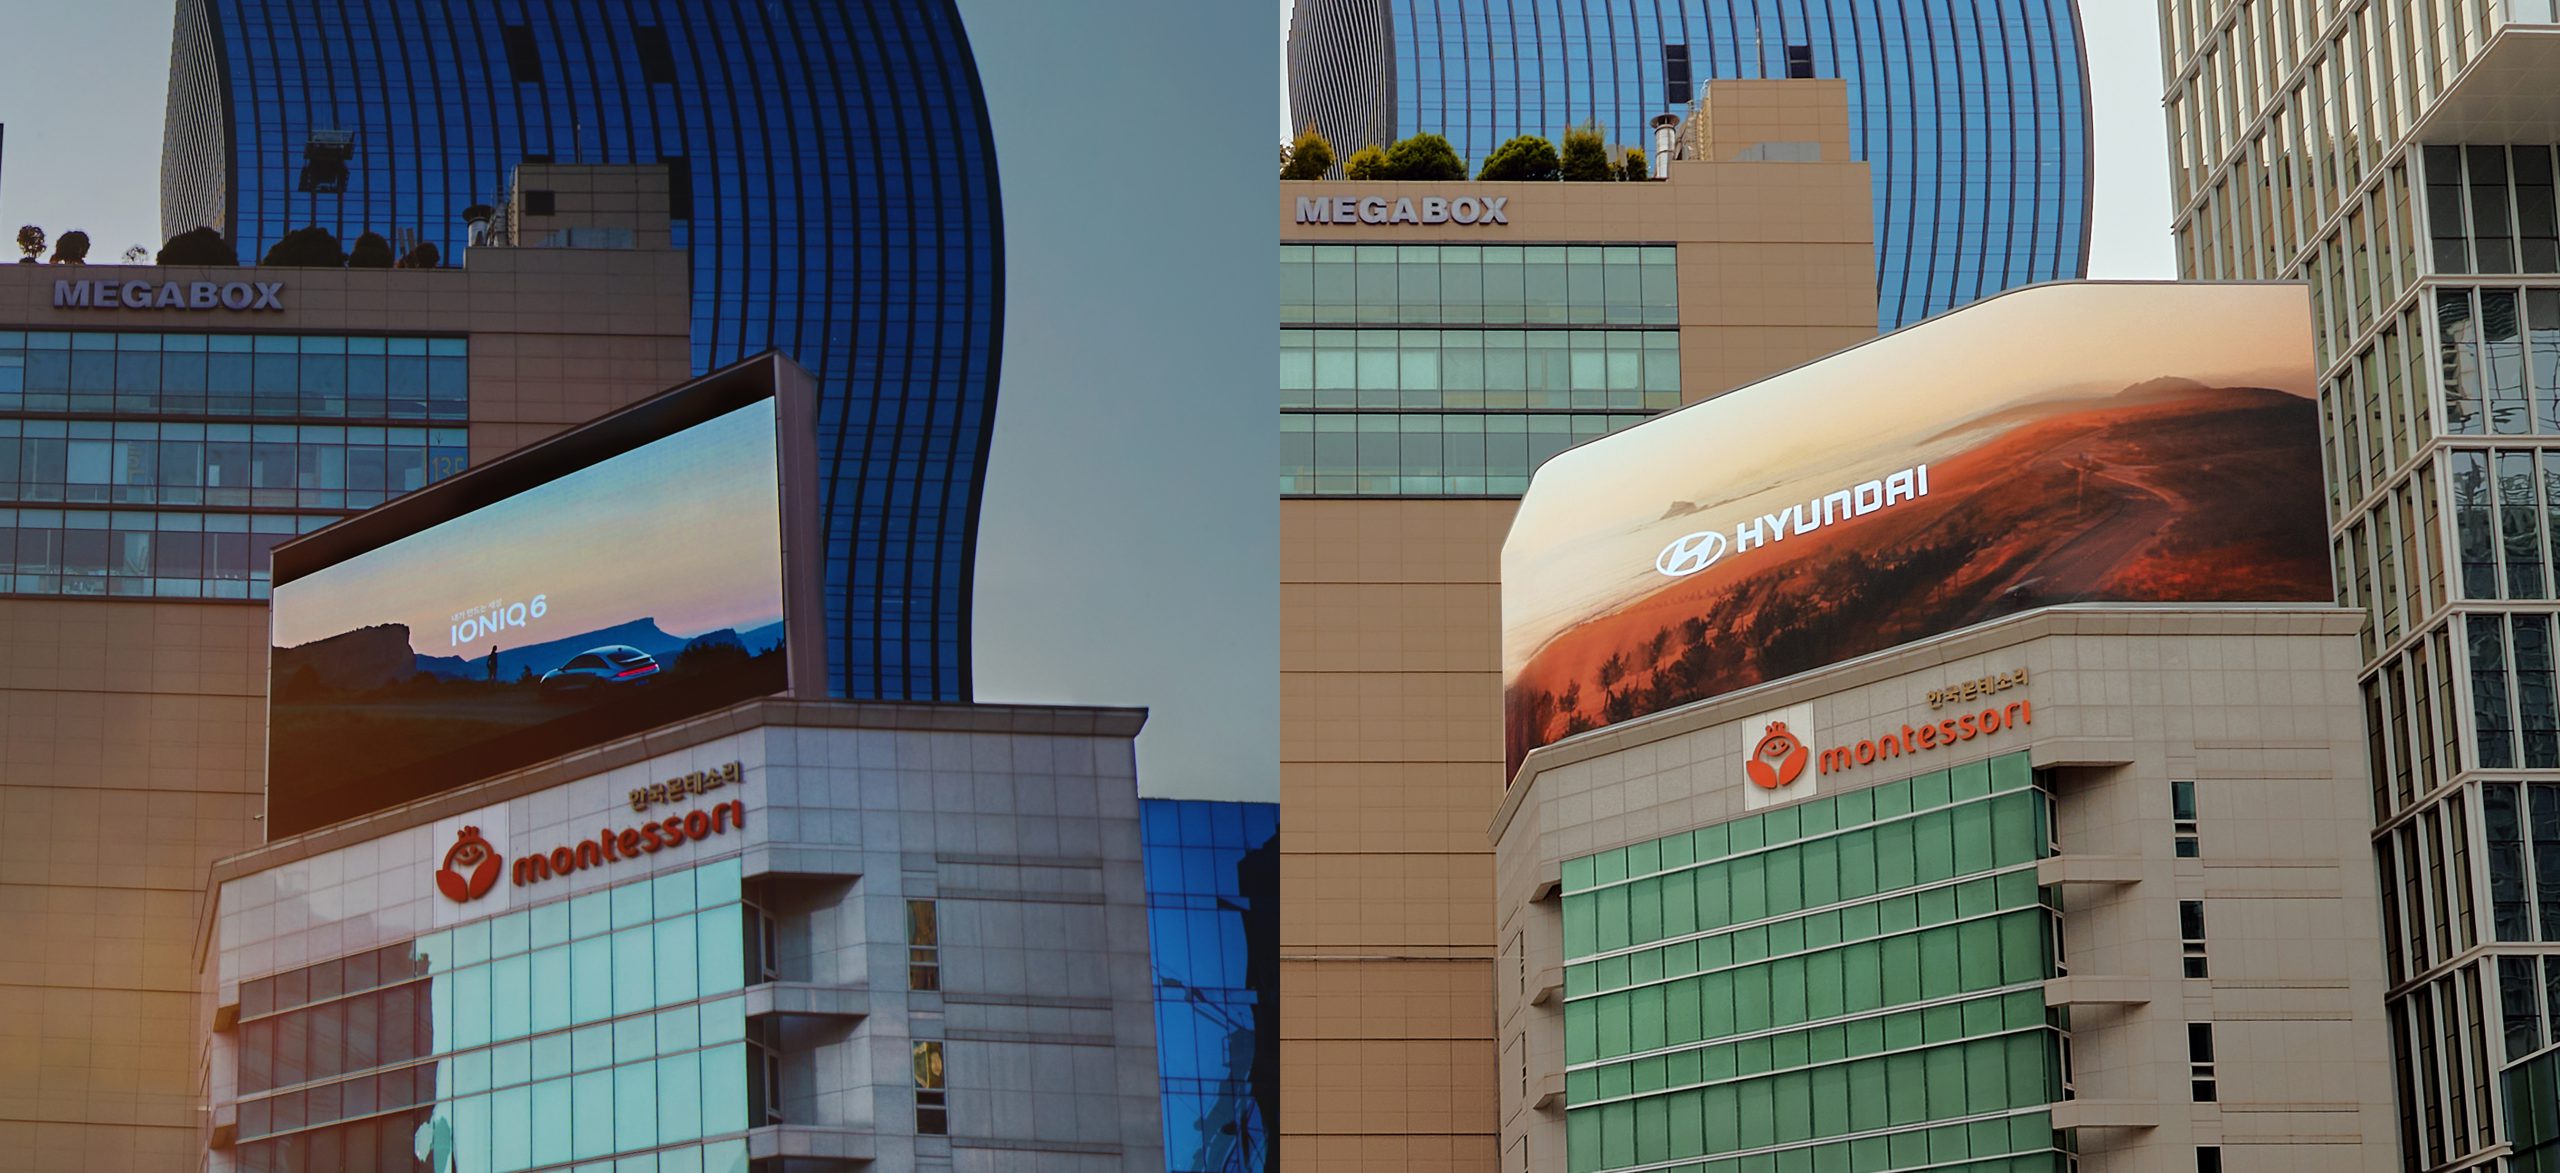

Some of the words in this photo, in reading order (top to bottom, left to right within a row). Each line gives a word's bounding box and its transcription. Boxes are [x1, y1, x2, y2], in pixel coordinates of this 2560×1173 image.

[1295, 196, 1509, 225] MEGABOX
[53, 279, 285, 311] MEGABOX
[1736, 463, 1929, 553] HYUNDAI
[451, 602, 526, 647] IONIQ
[530, 593, 548, 618] 6
[1926, 667, 2030, 710] 한국몬테소리
[1818, 699, 2032, 776] montessori
[628, 760, 744, 813] 한국몬테소리
[512, 799, 744, 887] montessori
